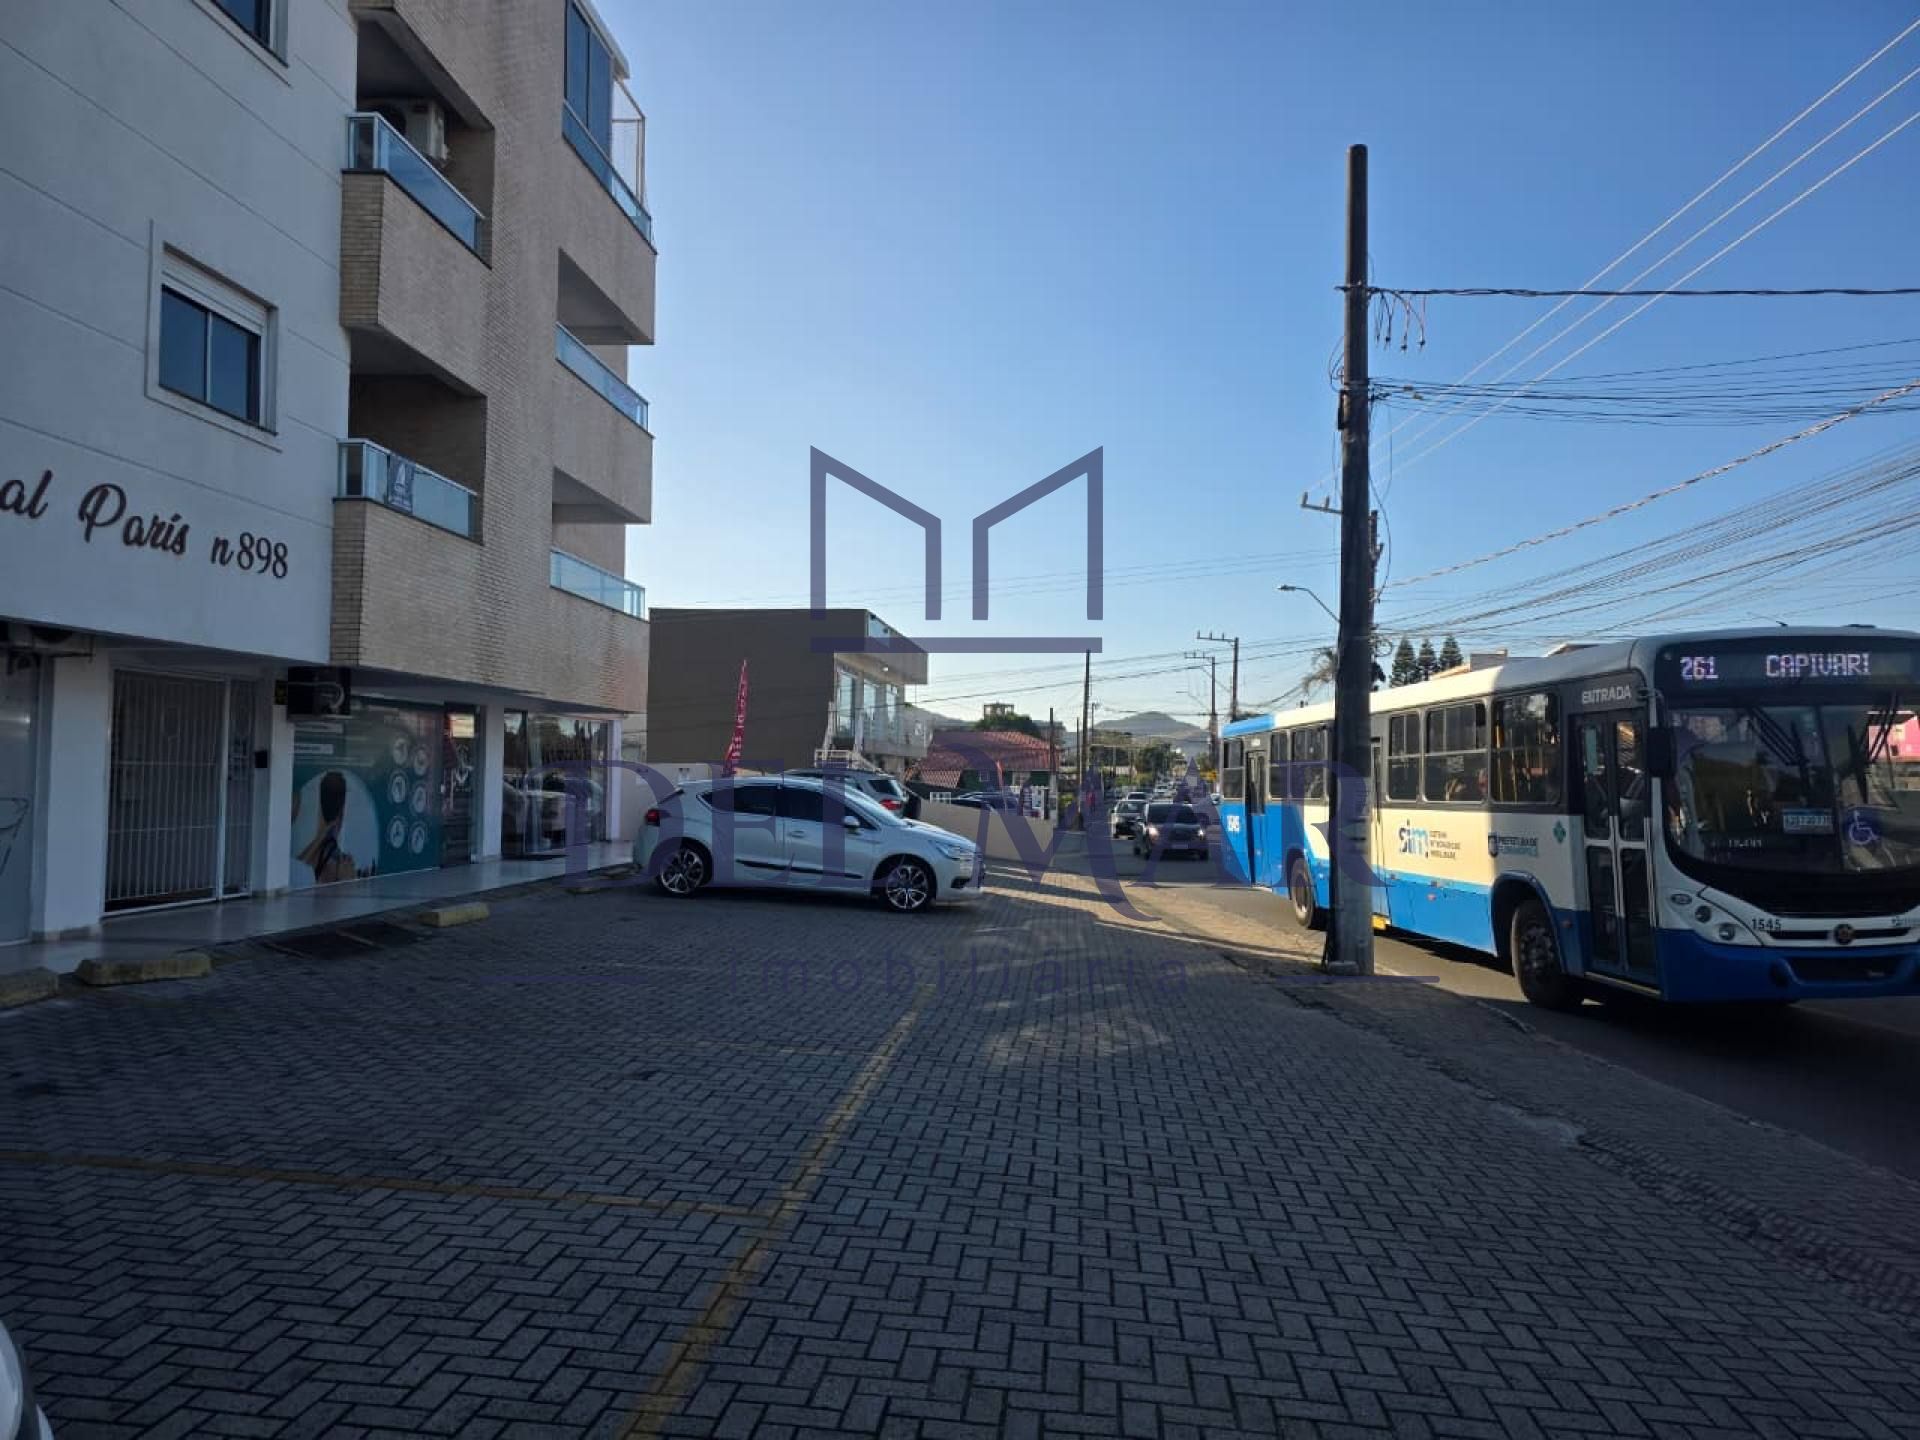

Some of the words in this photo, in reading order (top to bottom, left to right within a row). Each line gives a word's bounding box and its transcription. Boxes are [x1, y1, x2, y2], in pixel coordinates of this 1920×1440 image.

[0, 469, 53, 519] al
[1680, 656, 1719, 680] 261
[1766, 653, 1872, 678] CAPIVARI
[1752, 918, 1782, 931] 1545
